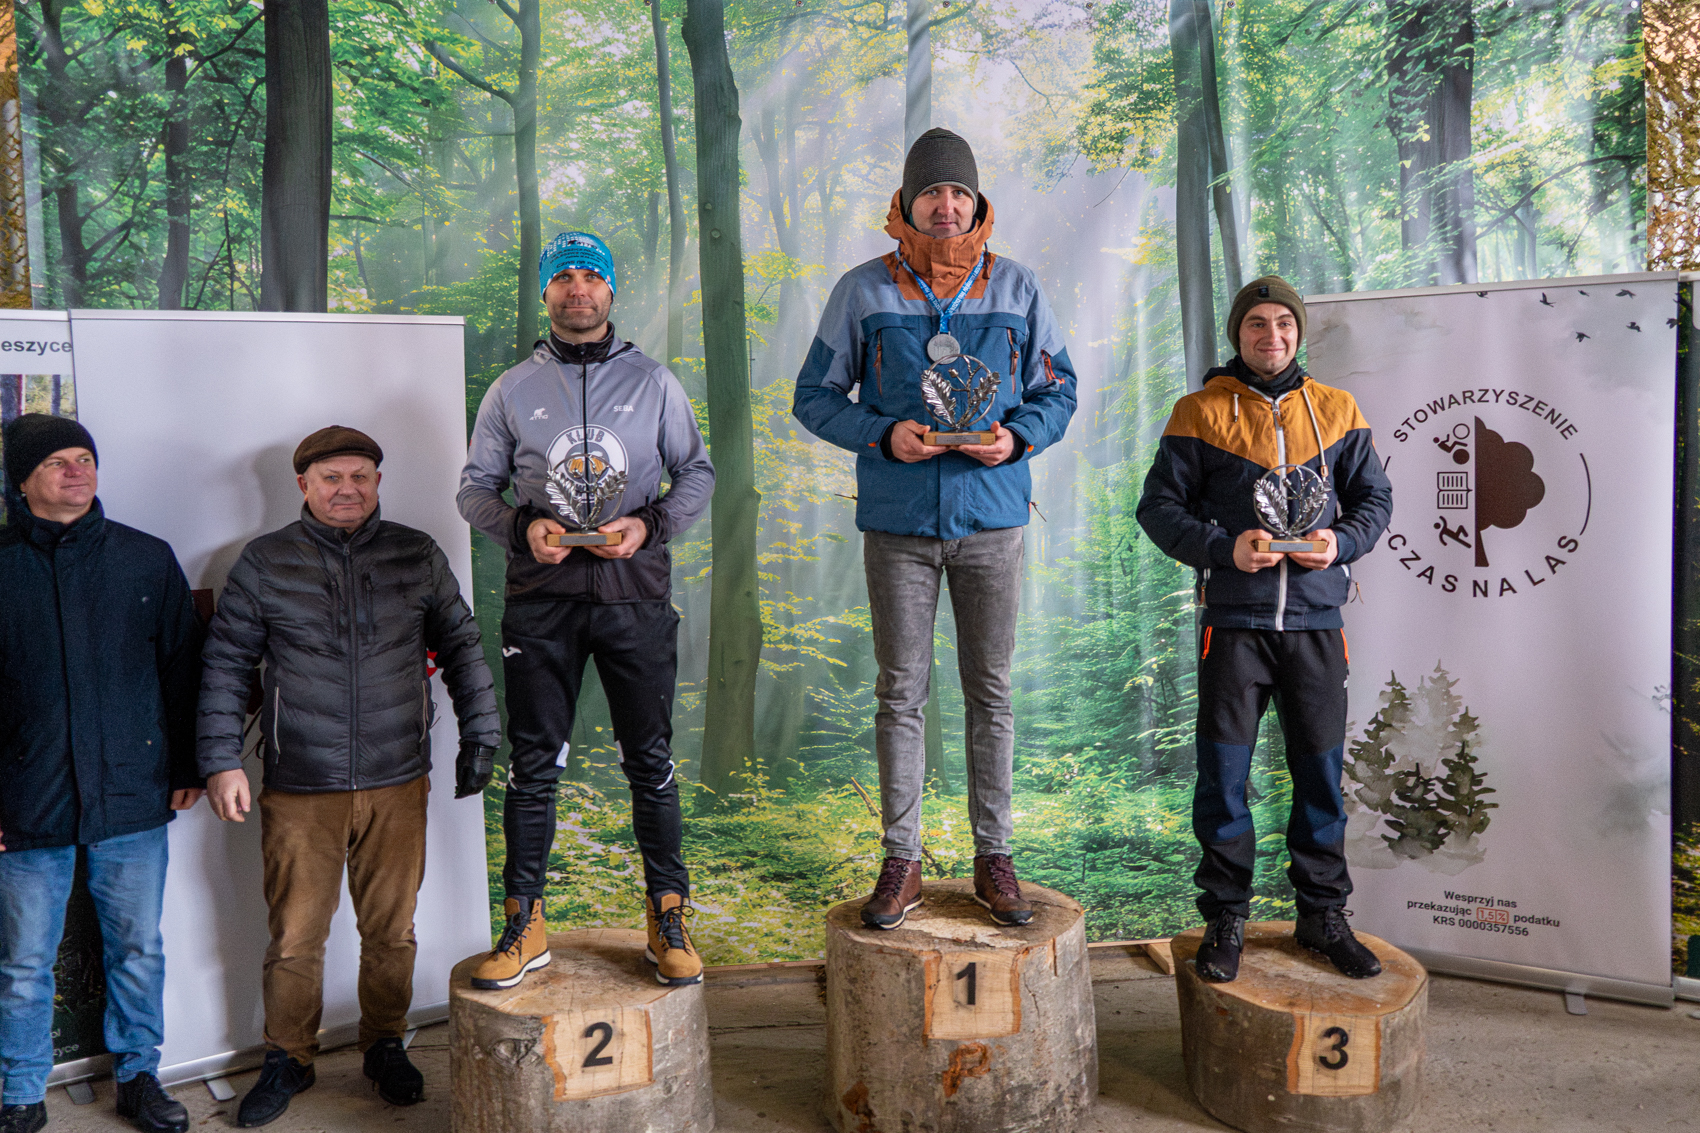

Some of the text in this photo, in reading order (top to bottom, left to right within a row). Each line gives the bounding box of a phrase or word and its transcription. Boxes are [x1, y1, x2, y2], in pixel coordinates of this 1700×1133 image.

[1, 340, 72, 356] eszyce
[1393, 388, 1578, 442] STOWARZYSZENIE
[565, 428, 605, 445] KLUB
[1387, 533, 1579, 598] CZAS NA LAS
[1406, 900, 1472, 917] przekazując
[1513, 914, 1560, 928] podatku
[1444, 890, 1517, 909] Wesprzyj nas
[1433, 915, 1529, 937] KRS 0000357556
[956, 962, 976, 1005] 1
[581, 1021, 613, 1068] 2
[1319, 1027, 1349, 1071] 3
